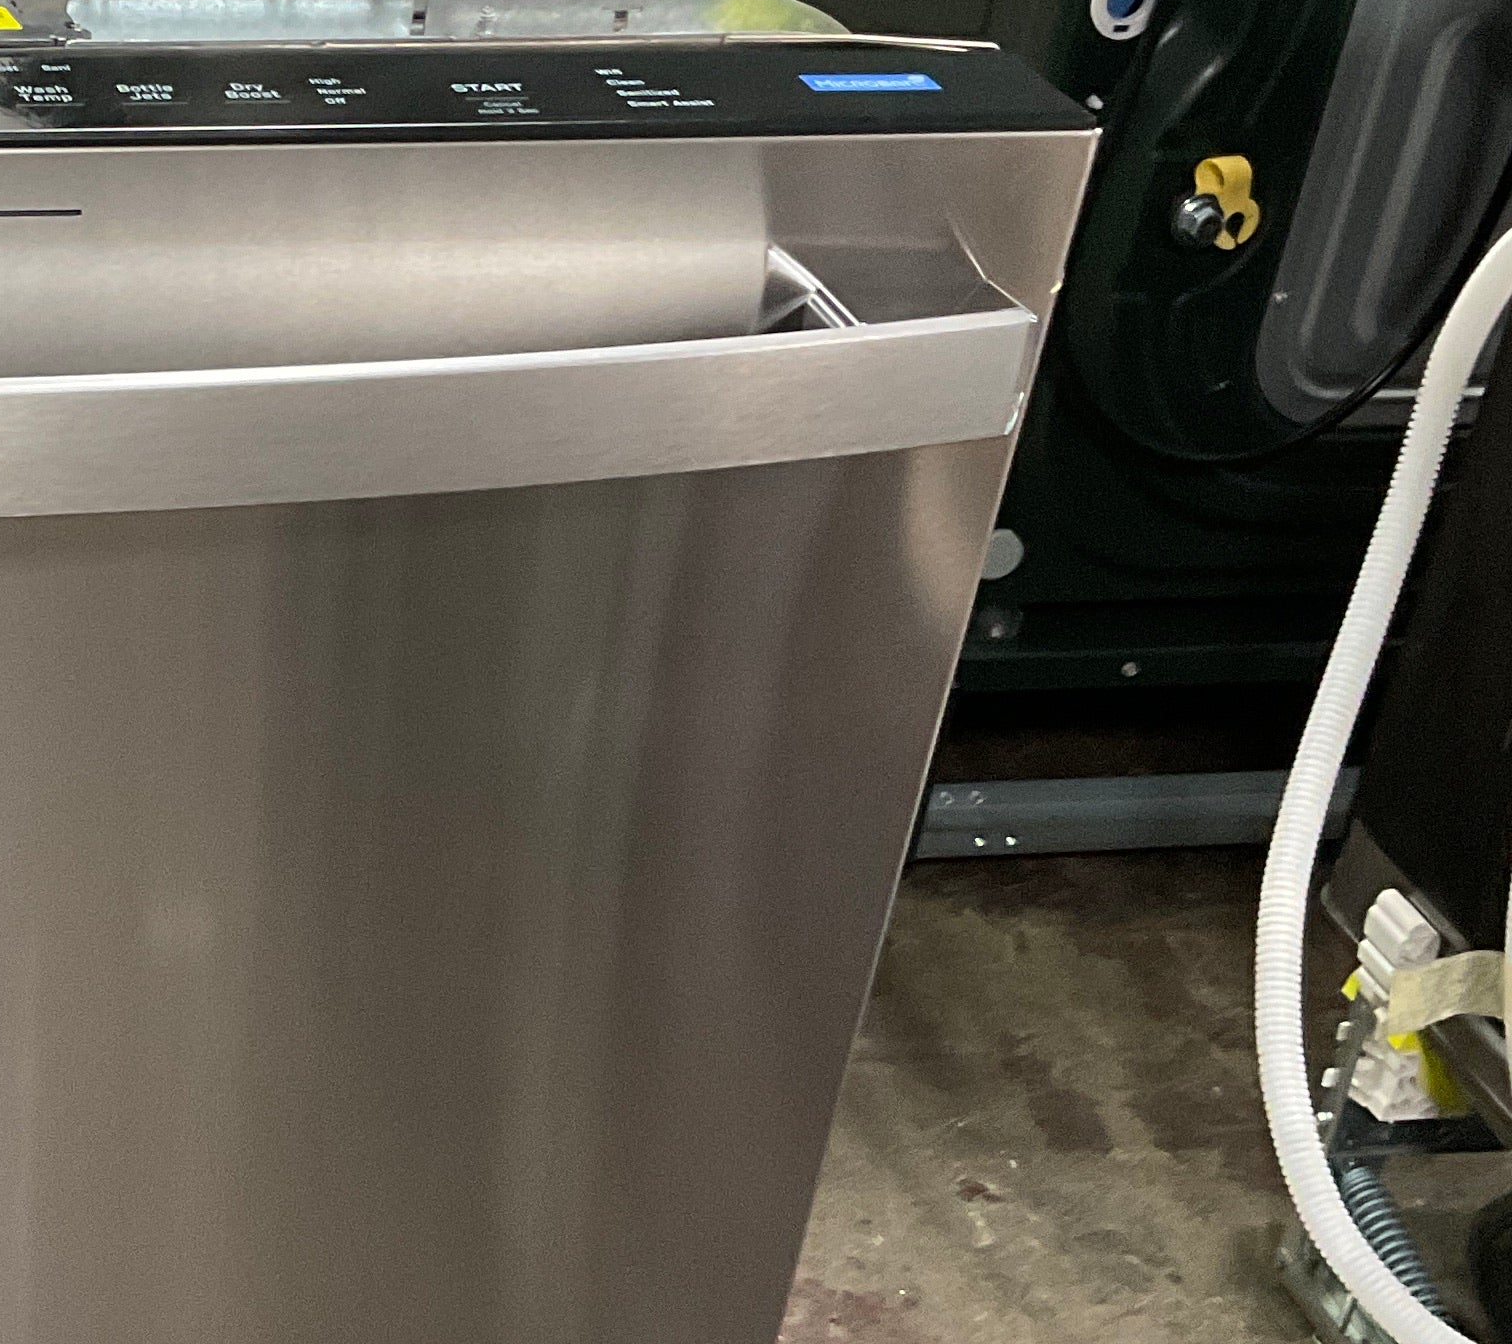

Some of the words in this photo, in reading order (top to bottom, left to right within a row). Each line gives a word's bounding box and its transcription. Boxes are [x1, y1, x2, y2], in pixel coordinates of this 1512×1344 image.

[308, 78, 341, 86] High
[14, 85, 69, 94] Wash
[115, 83, 174, 93] Bottle
[229, 82, 264, 92] Dry
[316, 87, 367, 95] Normal
[450, 83, 523, 93] START
[18, 94, 73, 103] Temp
[129, 92, 173, 101] Jets
[224, 89, 282, 99] Boost
